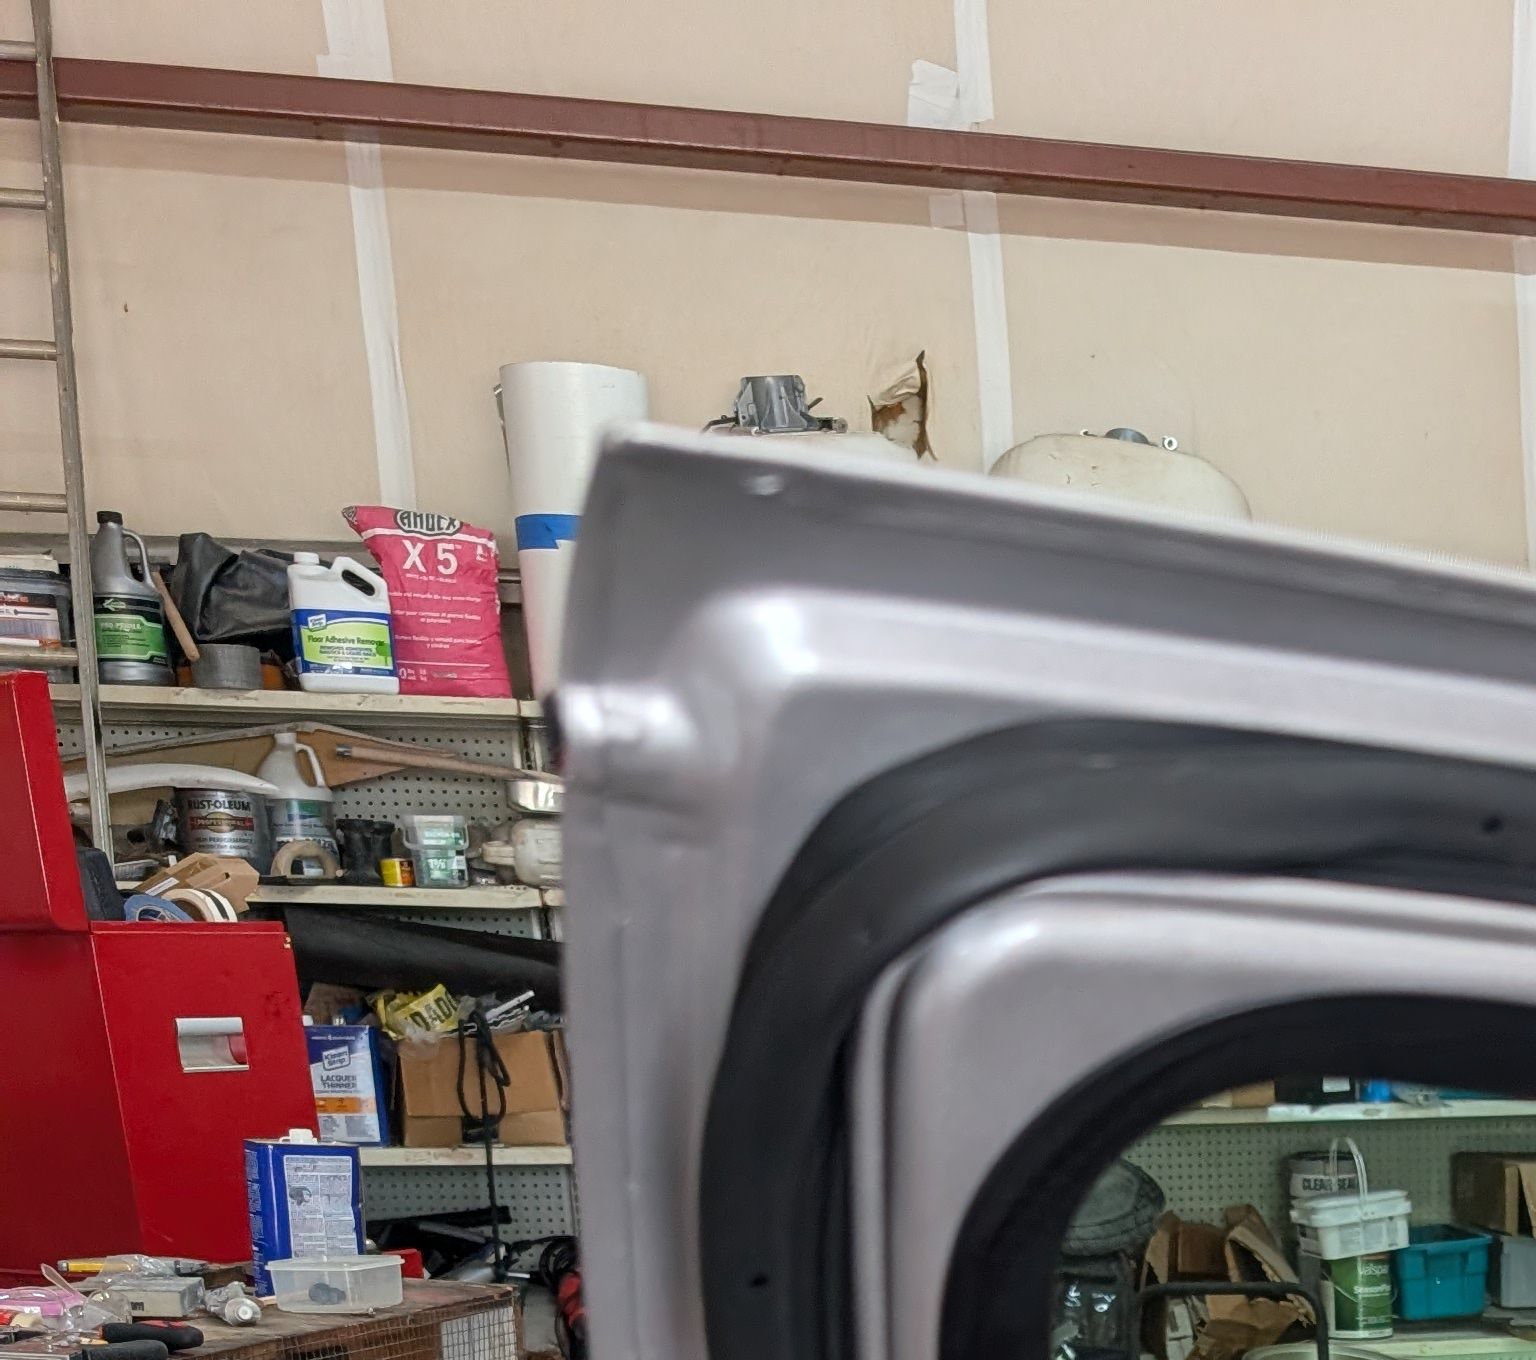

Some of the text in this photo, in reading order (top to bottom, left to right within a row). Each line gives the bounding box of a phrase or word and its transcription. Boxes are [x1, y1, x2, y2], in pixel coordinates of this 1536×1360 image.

[402, 539, 458, 575] X 5
[307, 634, 324, 643] Floor
[325, 635, 356, 645] Adhesive
